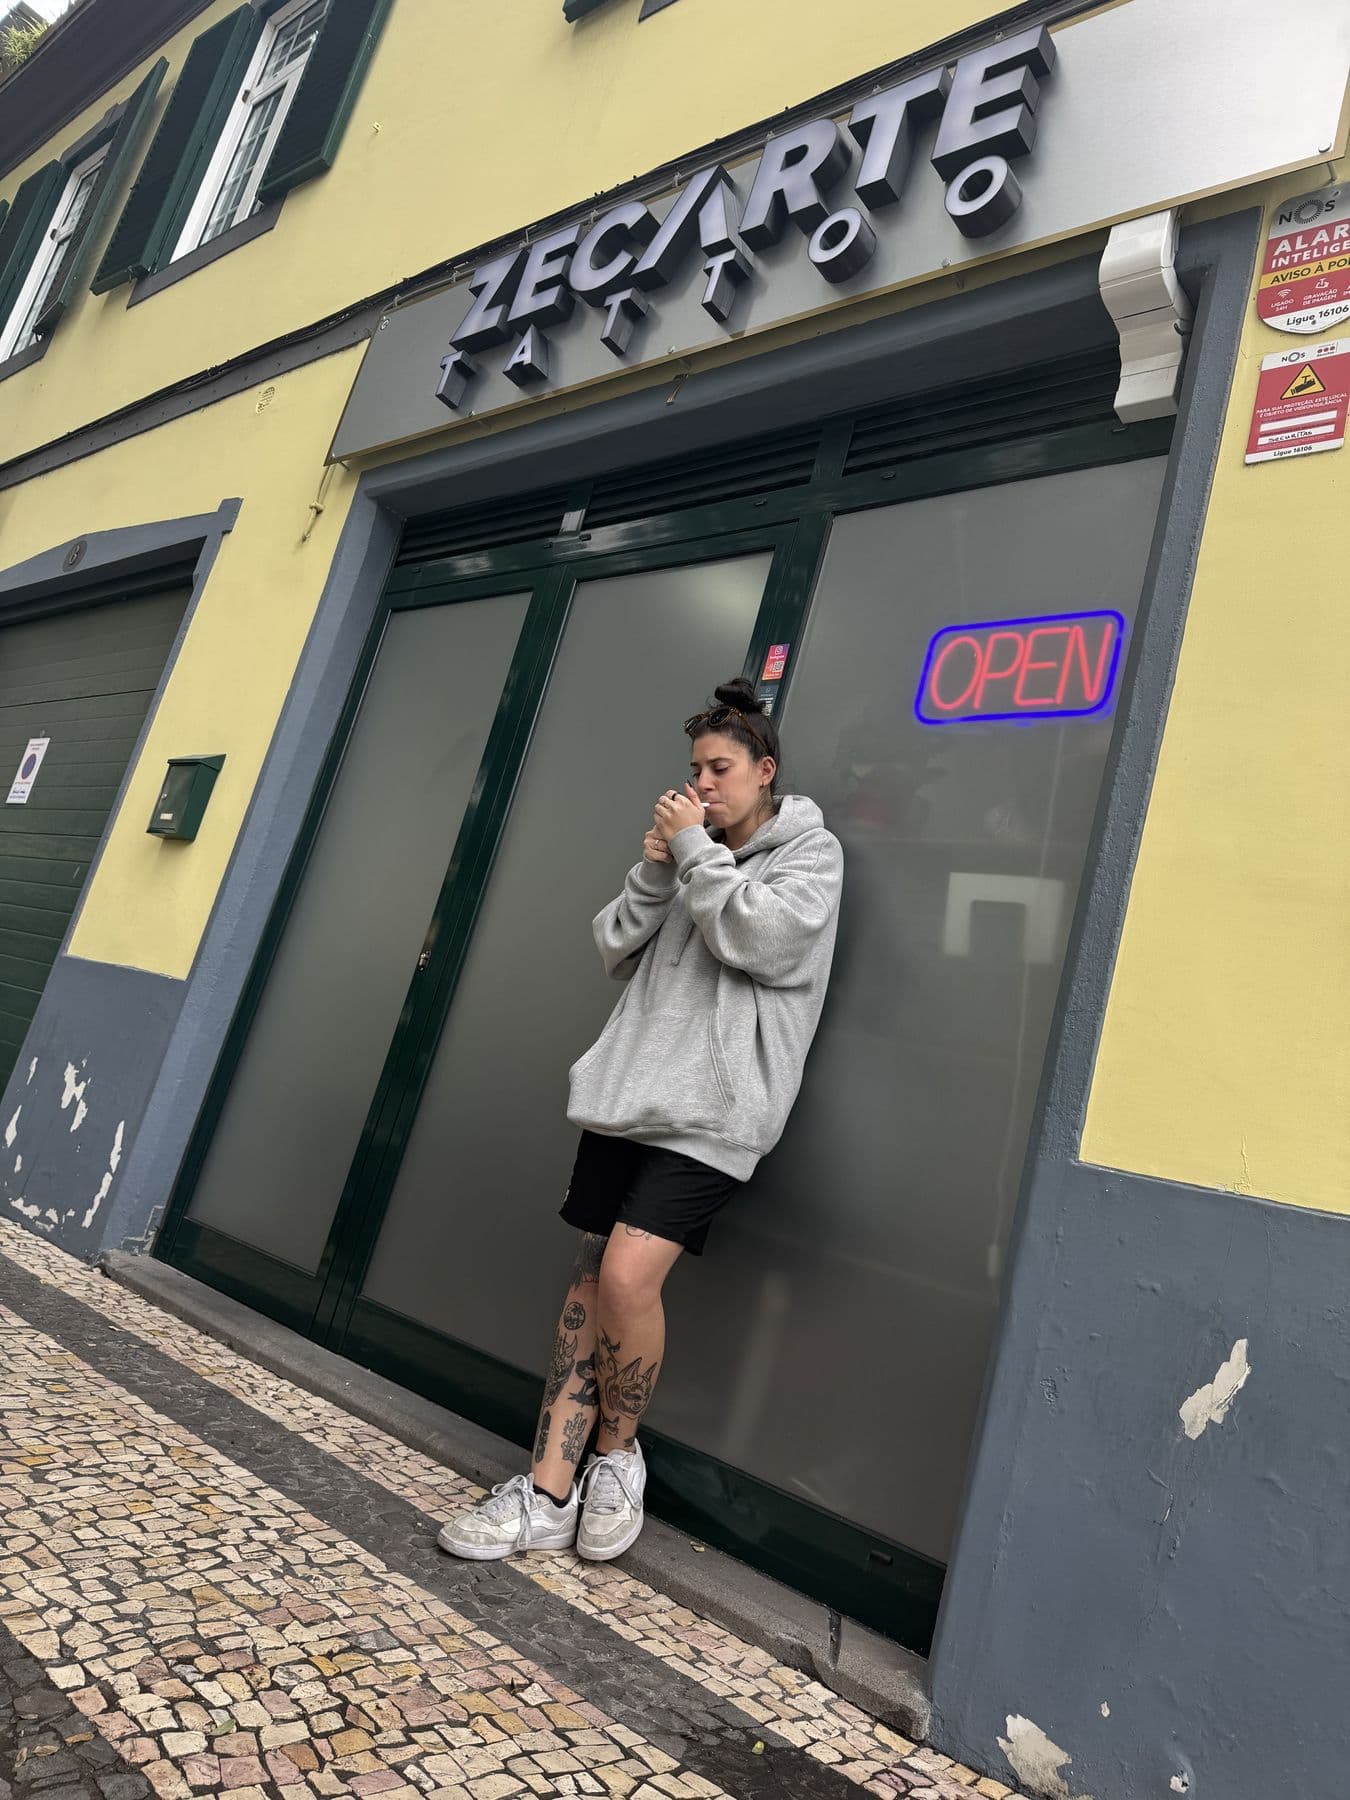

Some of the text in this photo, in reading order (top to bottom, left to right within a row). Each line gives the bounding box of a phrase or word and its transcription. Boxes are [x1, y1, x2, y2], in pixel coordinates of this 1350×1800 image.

[449, 24, 1056, 351] ZECARTE
[435, 155, 1022, 408] TATTOO
[1270, 267, 1311, 285] AVISO
[1314, 262, 1324, 274] À
[1286, 304, 1349, 326] Ligue 16106
[1281, 352, 1305, 362] NOS
[930, 622, 1113, 710] OPEN
